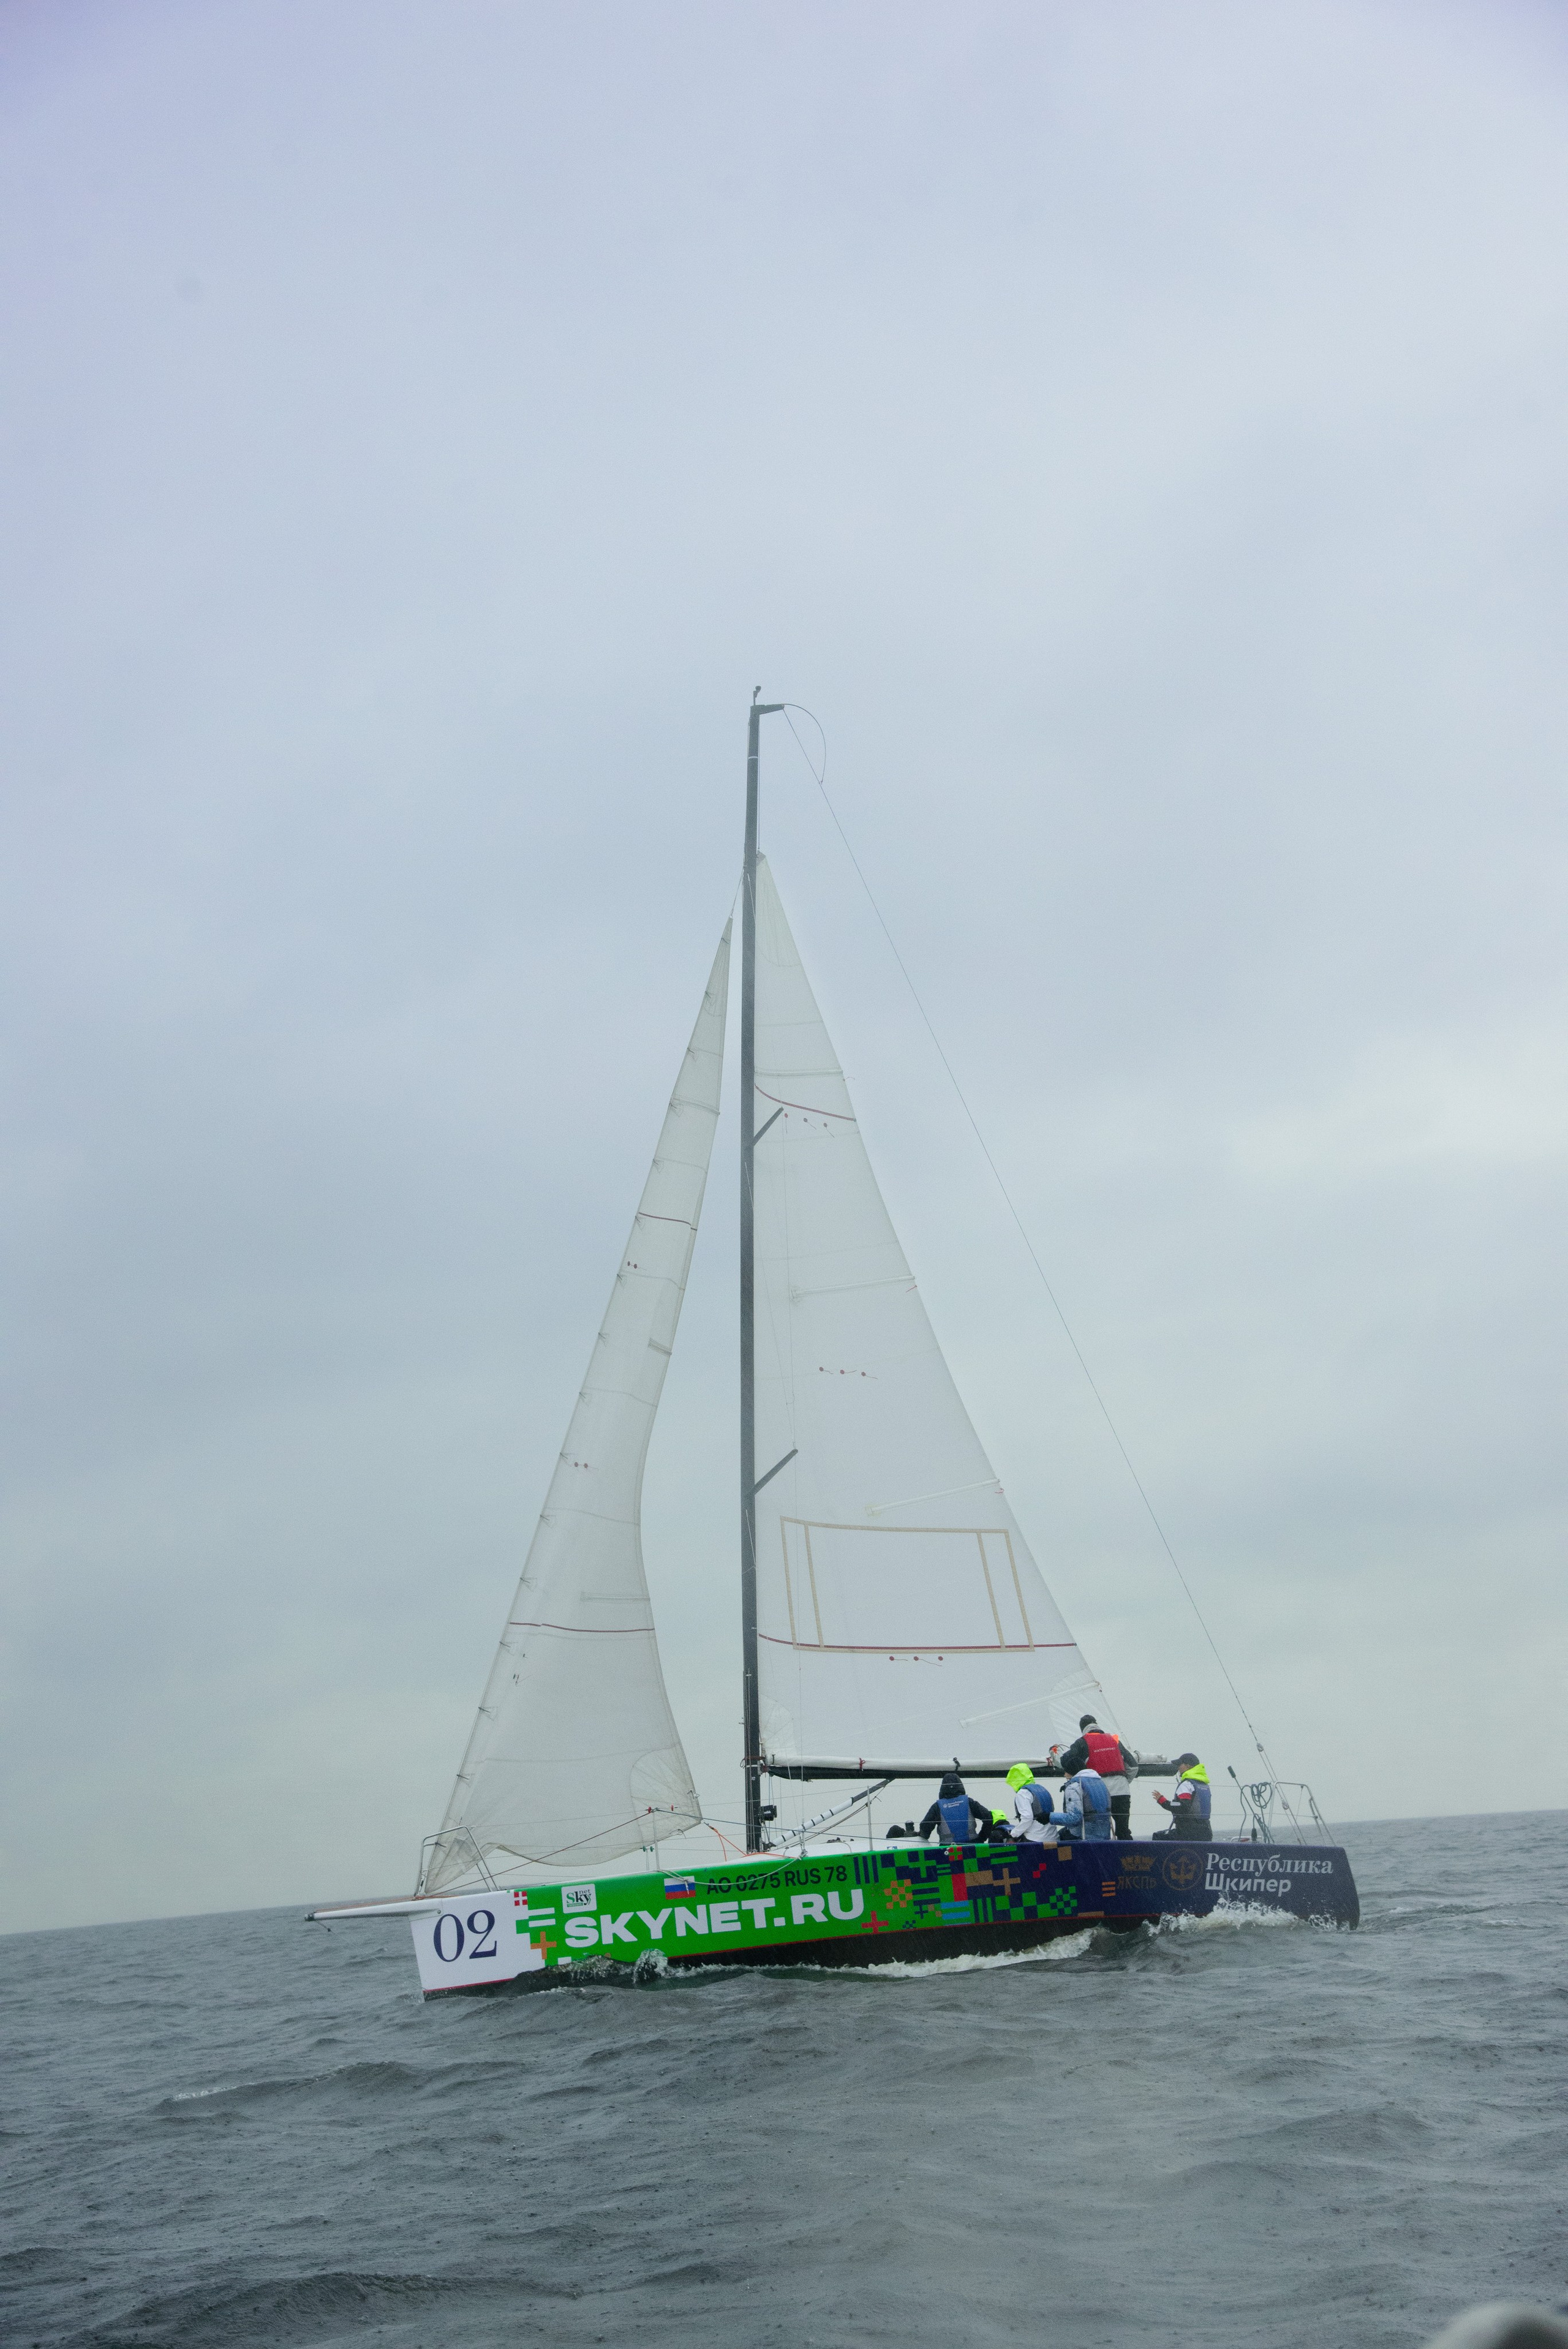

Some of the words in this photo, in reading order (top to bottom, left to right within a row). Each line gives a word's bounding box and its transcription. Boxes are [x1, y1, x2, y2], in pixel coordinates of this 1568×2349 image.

[1205, 1853, 1333, 1877] Республика
[736, 1872, 781, 1891] 0275
[784, 1868, 821, 1887] RUS
[824, 1865, 848, 1883] 78
[1205, 1873, 1291, 1897] Шкипер
[566, 1891, 592, 1906] Sky
[564, 1888, 864, 1948] SKYNET.RU
[433, 1909, 497, 1963] 02
